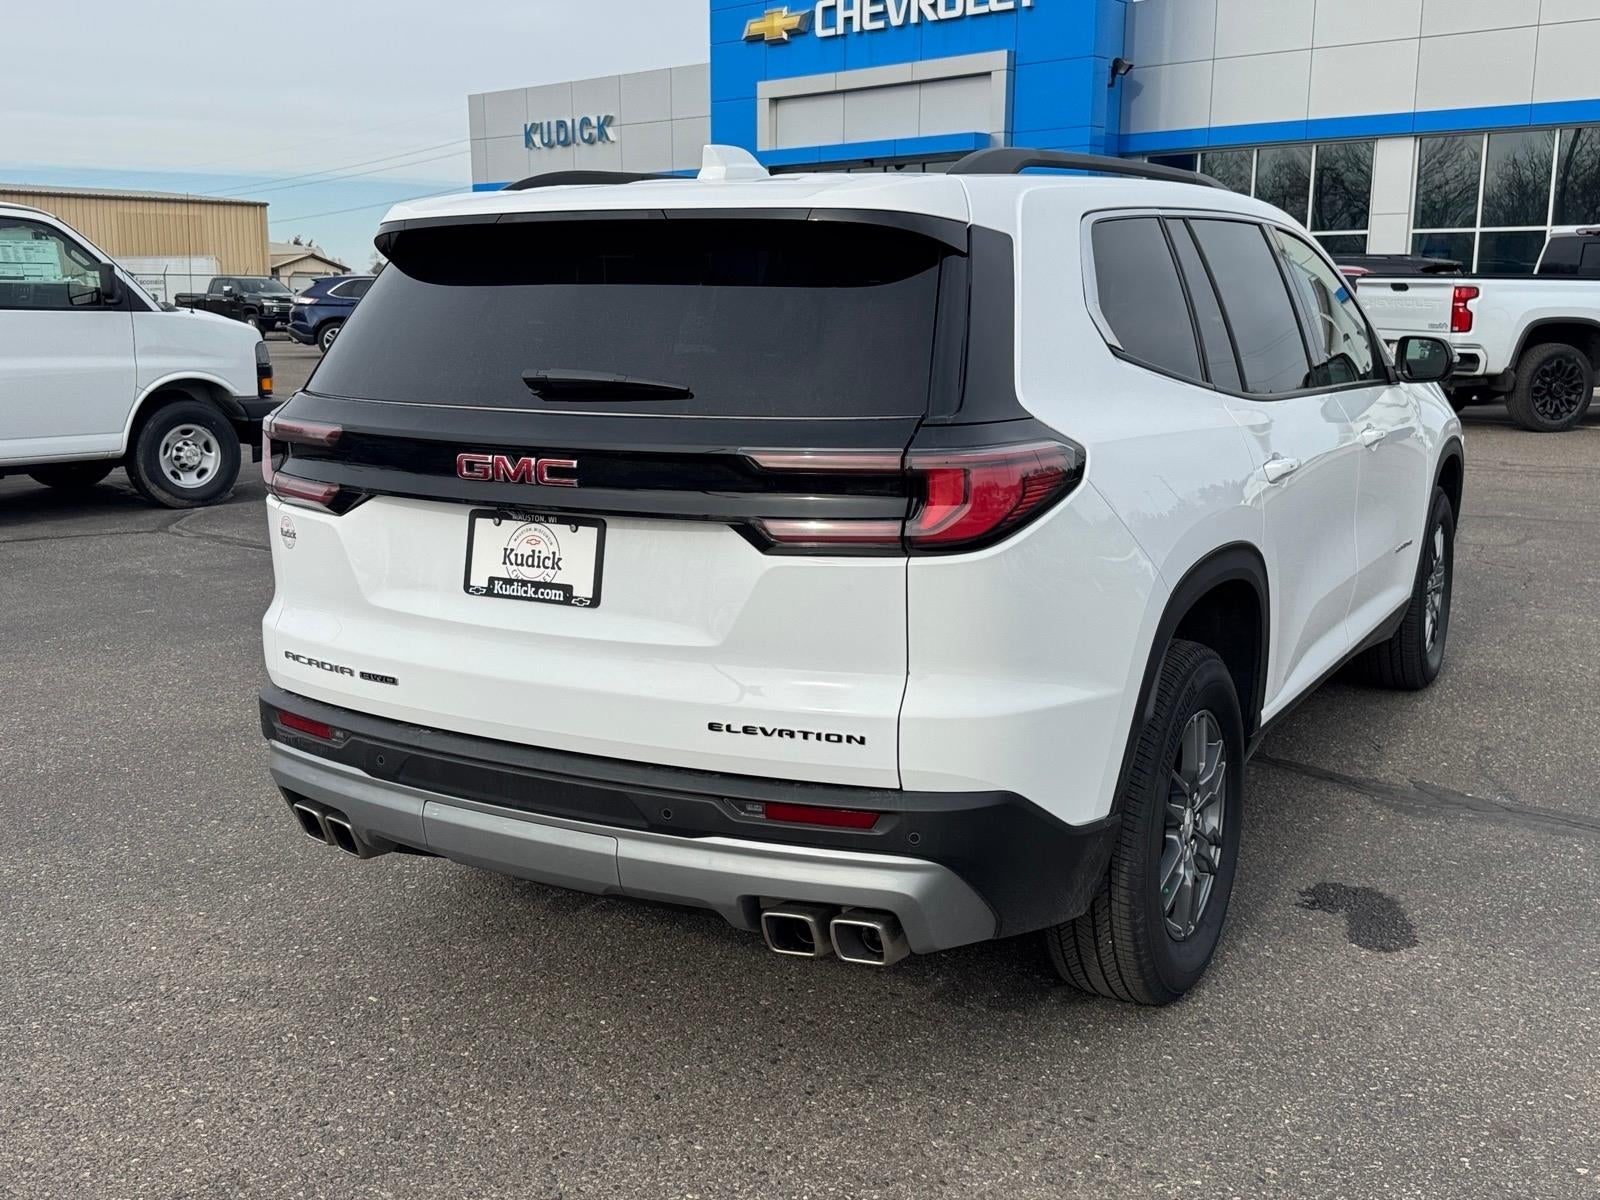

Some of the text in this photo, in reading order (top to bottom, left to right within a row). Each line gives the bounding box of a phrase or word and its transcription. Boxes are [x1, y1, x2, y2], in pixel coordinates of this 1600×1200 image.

[815, 0, 1031, 38] CHEVROL
[523, 115, 616, 150] KUDICK
[456, 452, 579, 487] GMC
[502, 547, 563, 571] Kudick
[493, 580, 564, 601] Kudick.com
[284, 650, 355, 677] ACADIA
[707, 721, 867, 746] ELEVATION
